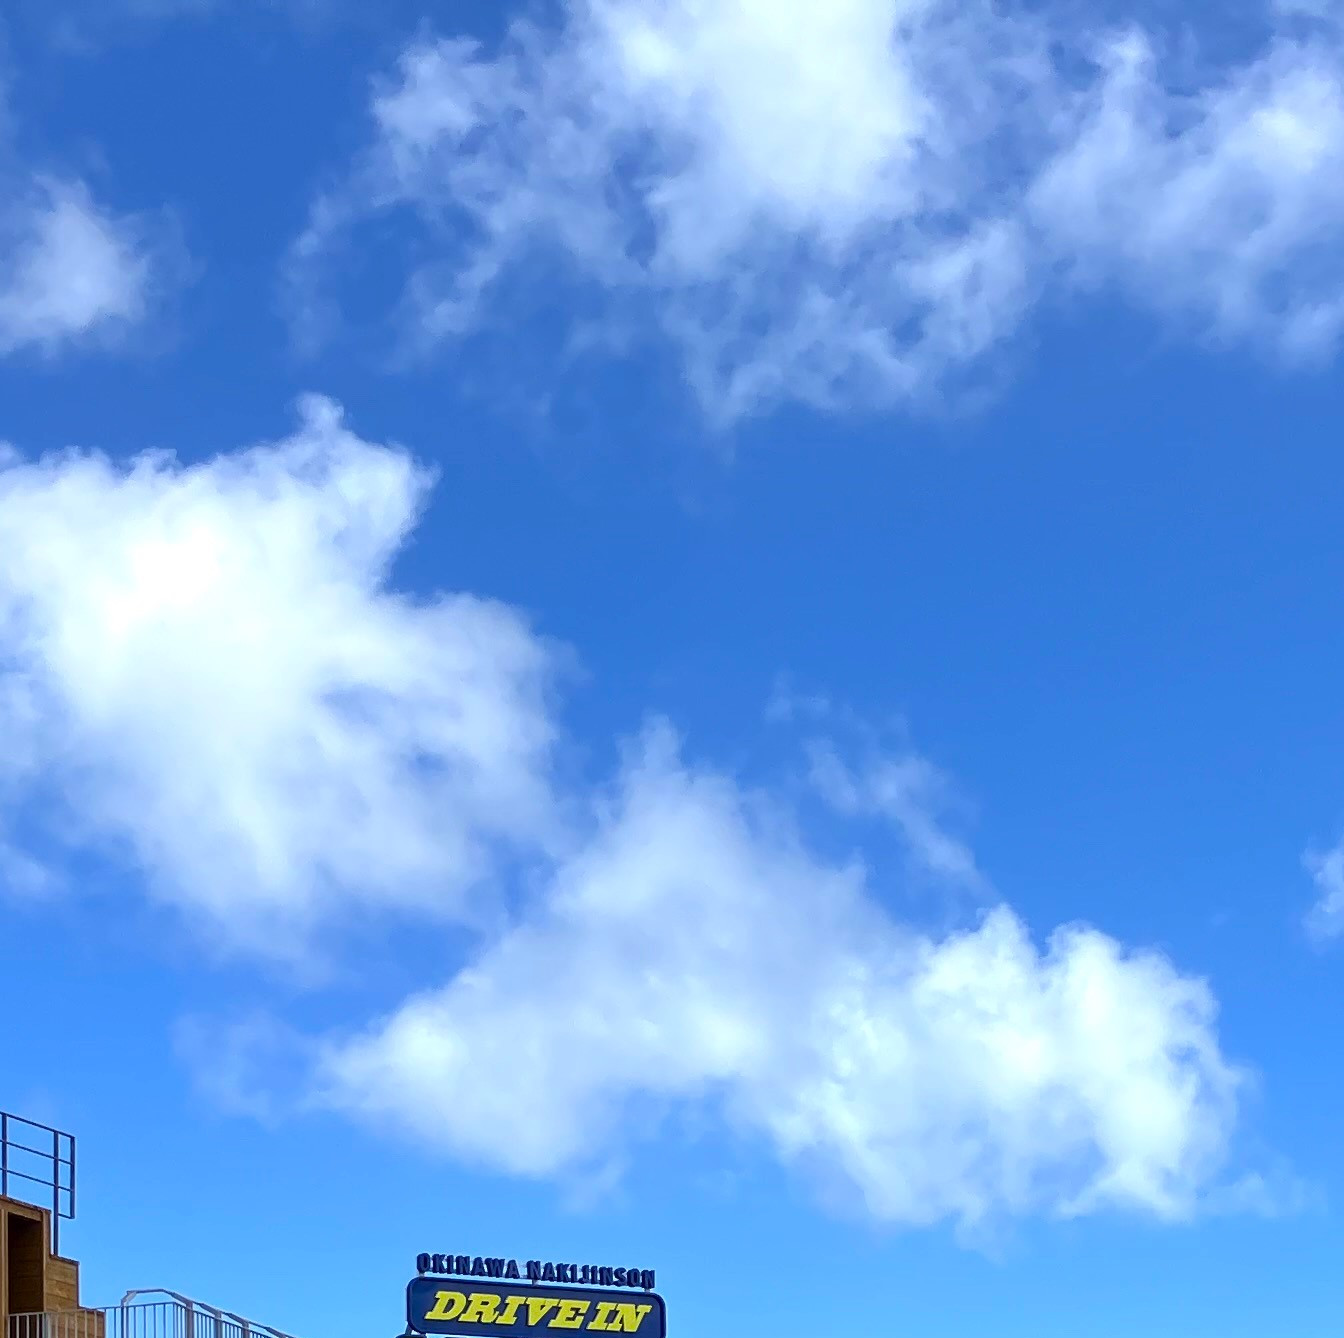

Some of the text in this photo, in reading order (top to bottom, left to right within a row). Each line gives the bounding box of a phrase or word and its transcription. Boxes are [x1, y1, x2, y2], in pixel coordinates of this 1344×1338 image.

[417, 1253, 655, 1289] OKINAWA NAKIJINSON
[424, 1290, 652, 1333] DRIVE IN
